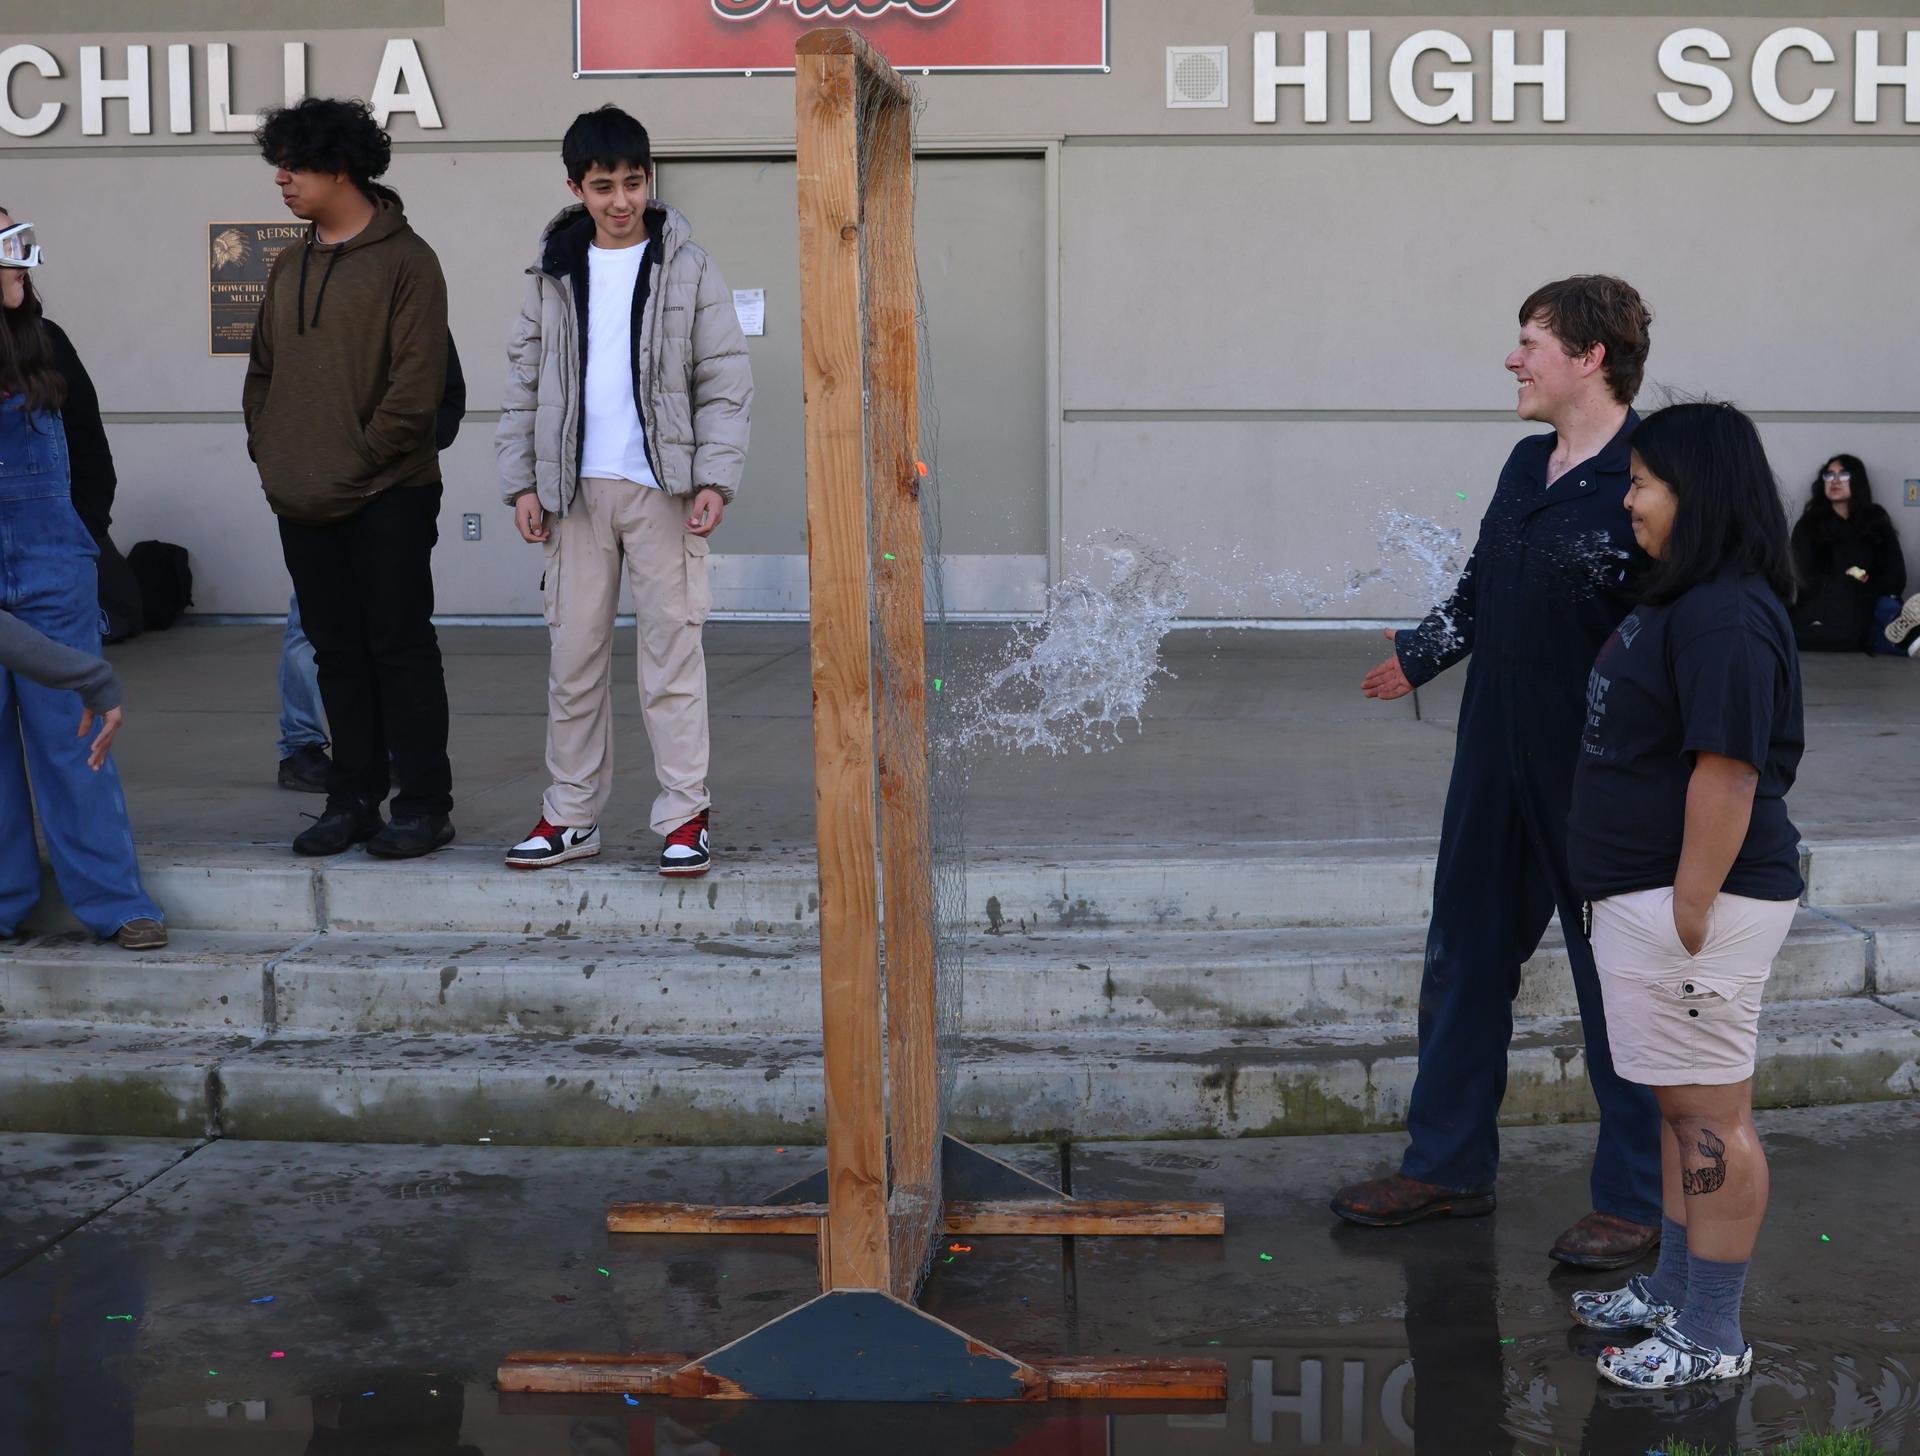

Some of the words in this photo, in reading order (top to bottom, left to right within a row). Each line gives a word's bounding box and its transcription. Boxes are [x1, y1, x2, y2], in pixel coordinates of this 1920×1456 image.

[1253, 29, 1566, 125] HIGH
[1656, 27, 1920, 124] SCH
[257, 227, 308, 240] REDSKI
[231, 294, 266, 302] MULTI-
